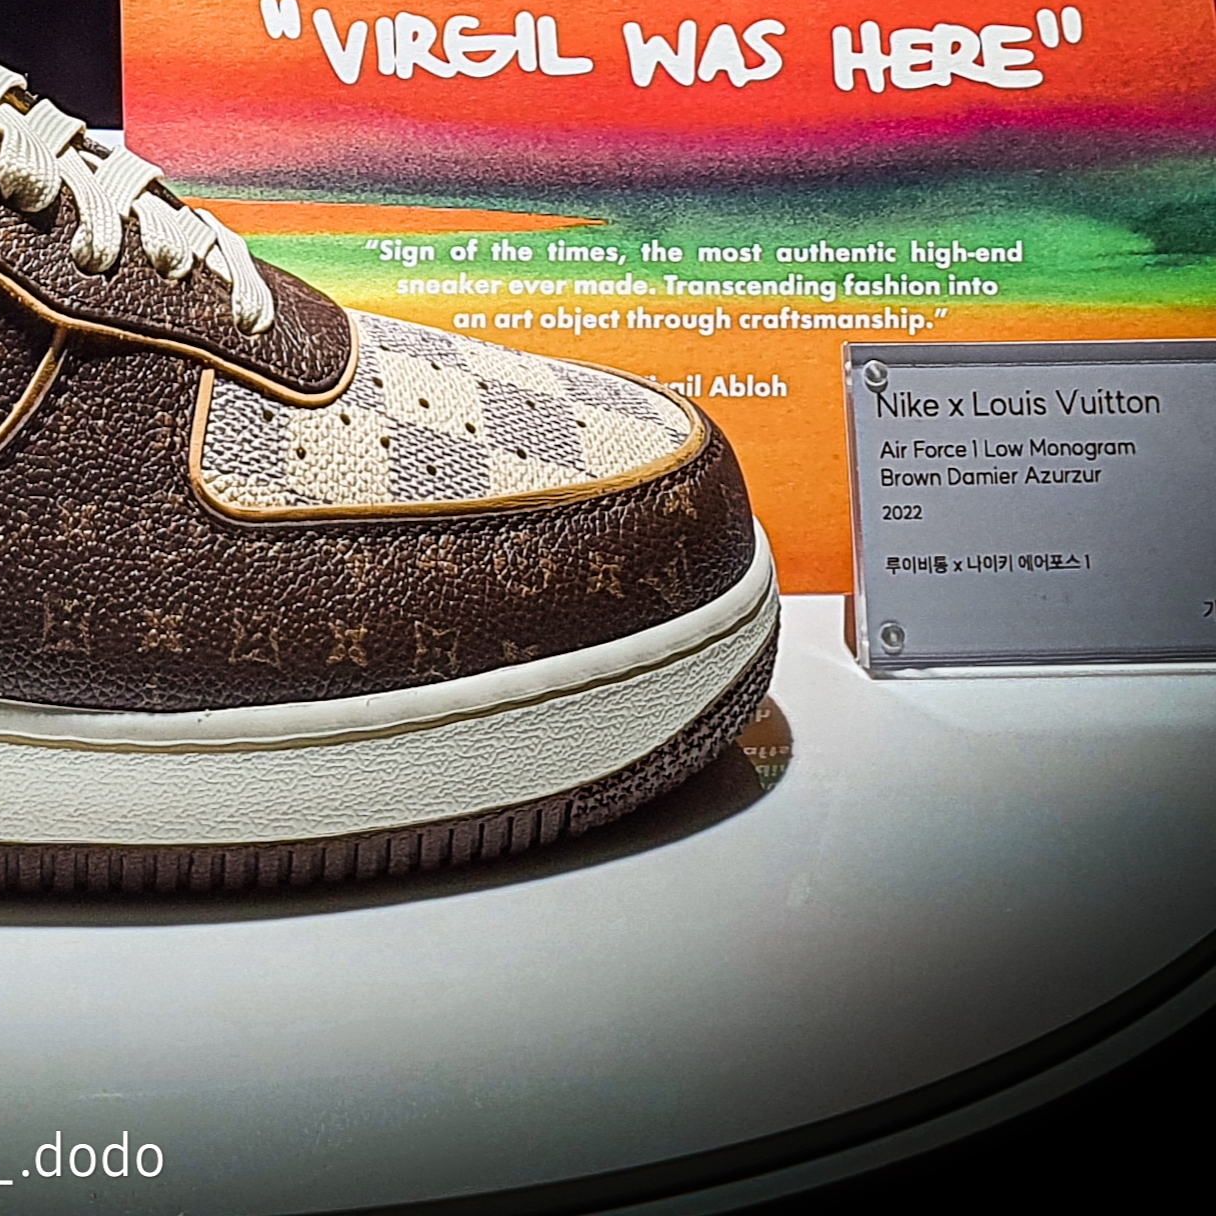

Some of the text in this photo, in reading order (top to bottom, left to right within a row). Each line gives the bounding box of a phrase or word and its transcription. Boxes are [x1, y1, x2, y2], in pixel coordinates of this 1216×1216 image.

[622, 19, 786, 88] WAS
[831, 6, 1082, 94] HERE"
[365, 239, 1024, 269] “Sign of the times, the most authentic high-end
[396, 272, 999, 303] sneaker ever made. Transcending fashion into
[453, 311, 486, 329] an
[494, 309, 534, 329] art
[540, 307, 621, 336] object
[626, 307, 732, 336] through
[708, 374, 788, 397] Abloh
[876, 388, 1161, 418] Nike x Louis Vuitton
[880, 438, 1136, 461] Air Force 1 Low Monogram
[881, 466, 1102, 487] Brown Damier Azurzur
[882, 504, 923, 521] 2022
[885, 555, 949, 575] 루이비통
[953, 560, 963, 572] x
[966, 554, 1014, 573] 나이키
